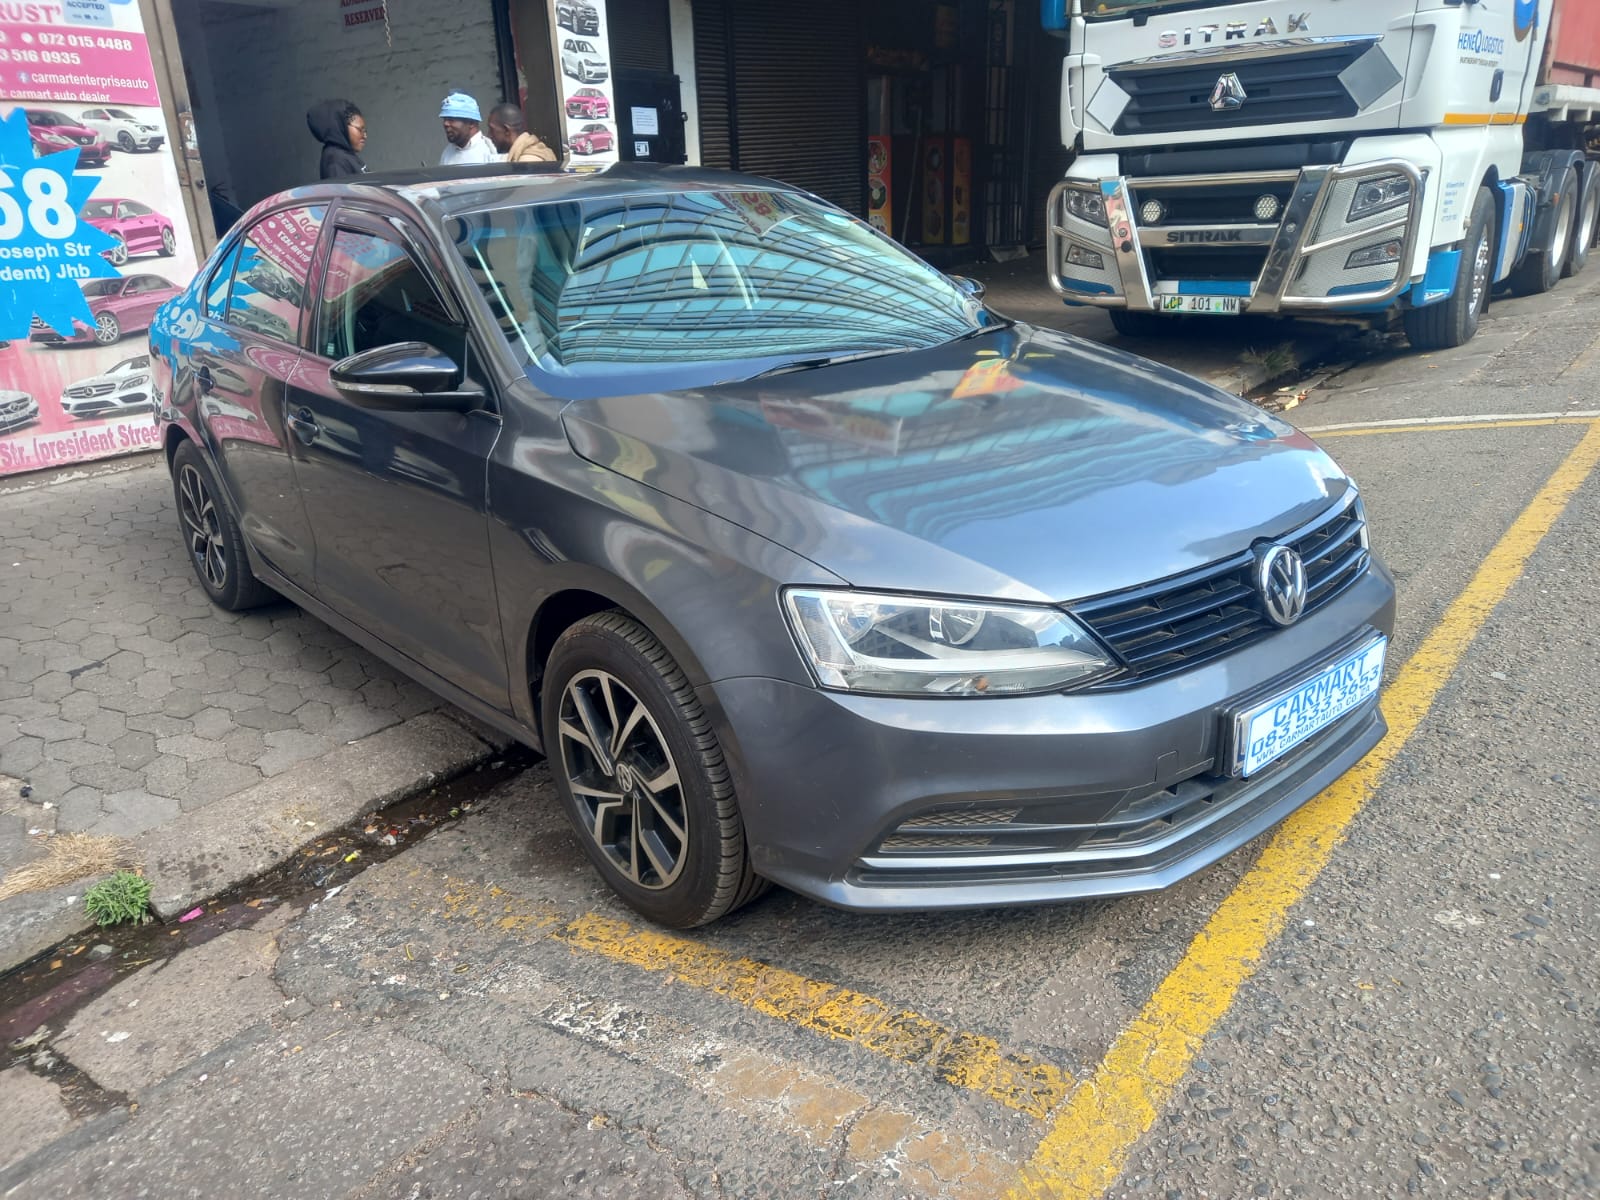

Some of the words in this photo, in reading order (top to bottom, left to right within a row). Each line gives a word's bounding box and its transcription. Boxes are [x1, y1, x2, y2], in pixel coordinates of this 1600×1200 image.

[66, 1, 105, 10] ACCEPTED
[1158, 12, 1311, 48] SITRAK
[38, 32, 65, 45] 072
[67, 34, 95, 48] 015
[97, 36, 132, 51] 4488
[11, 49, 39, 62] 516
[41, 50, 81, 65] 0935
[32, 72, 149, 89] carmartenterpriseauto
[1166, 230, 1242, 243] SITRAK
[64, 242, 92, 257] Str
[56, 263, 91, 278] Jhb
[1163, 296, 1184, 309] LCP
[1191, 297, 1212, 310] 101
[1222, 297, 1237, 311] NW
[0, 441, 30, 467] Str.
[33, 428, 117, 467] (president
[117, 424, 160, 447] Stree
[1273, 652, 1369, 728] CARMART
[1251, 720, 1291, 758] 083
[1296, 694, 1332, 729] 533
[1337, 664, 1379, 703] 3653
